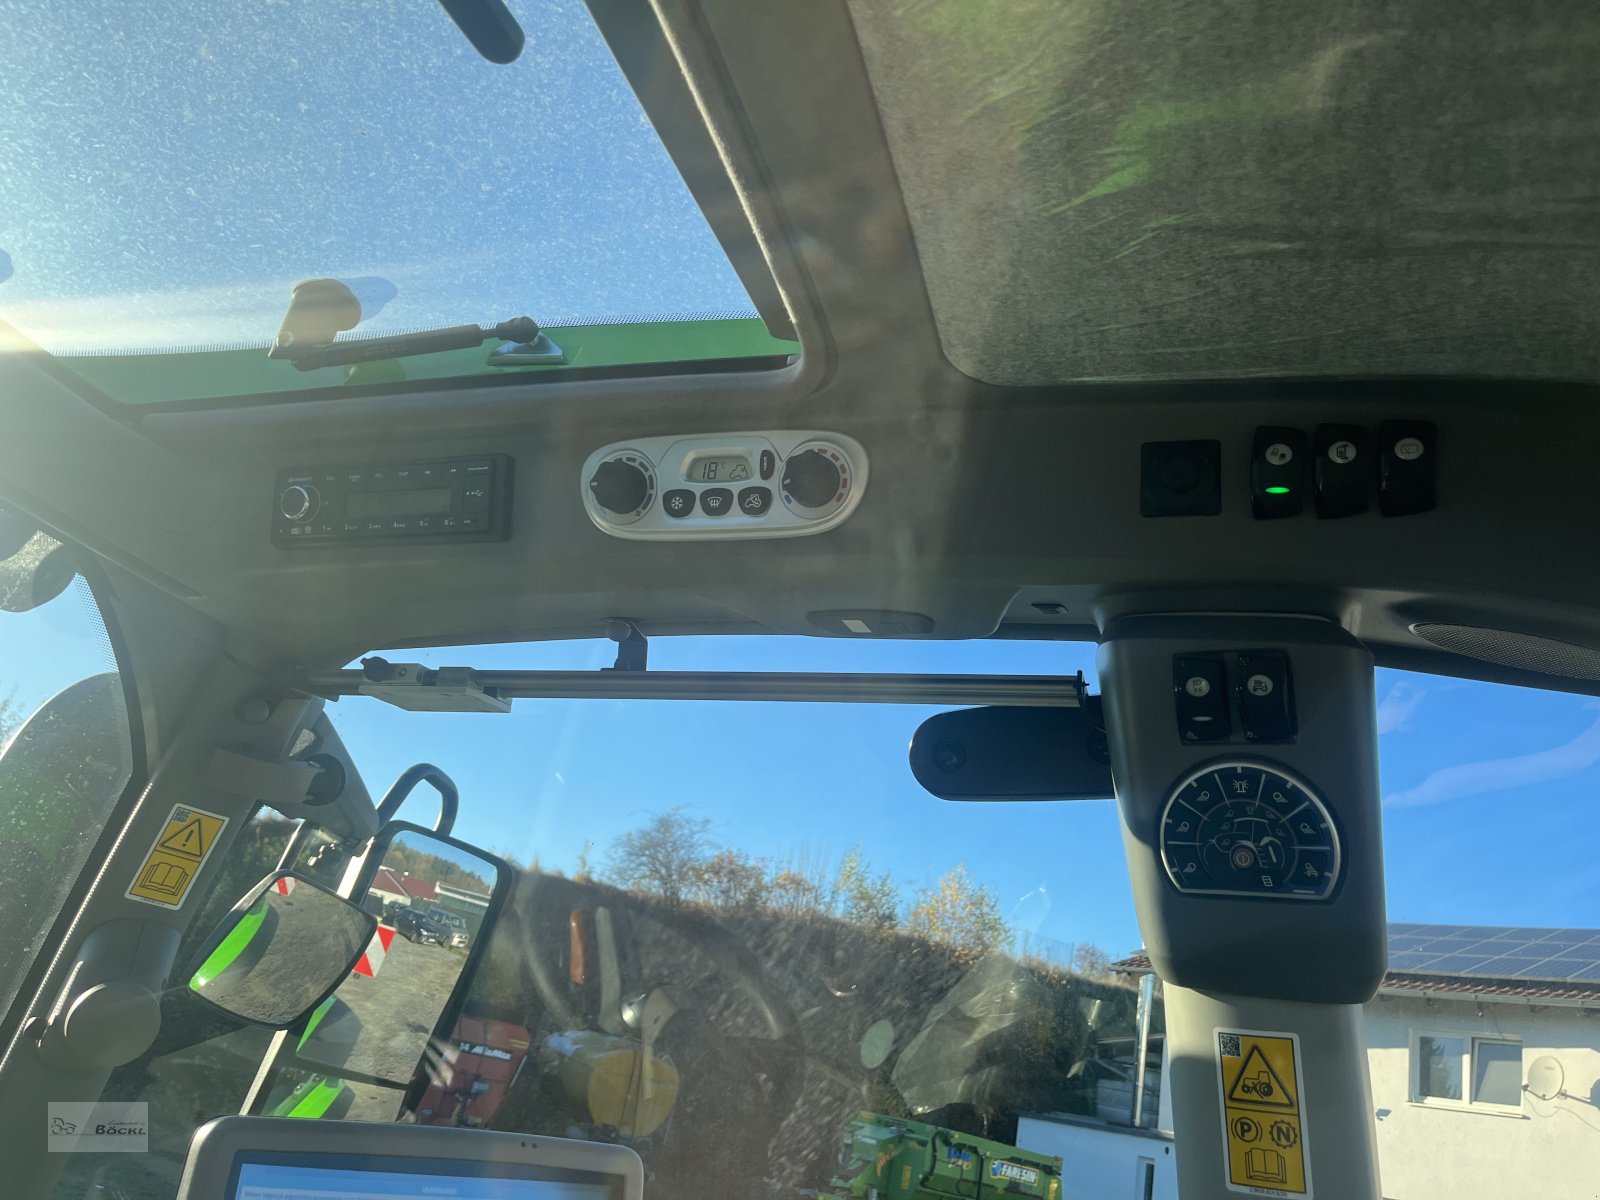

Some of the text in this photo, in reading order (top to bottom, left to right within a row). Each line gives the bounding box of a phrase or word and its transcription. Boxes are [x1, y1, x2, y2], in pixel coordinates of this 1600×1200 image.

[702, 462, 718, 480] 18
[1239, 1121, 1252, 1138] P
[1276, 1126, 1291, 1143] N
